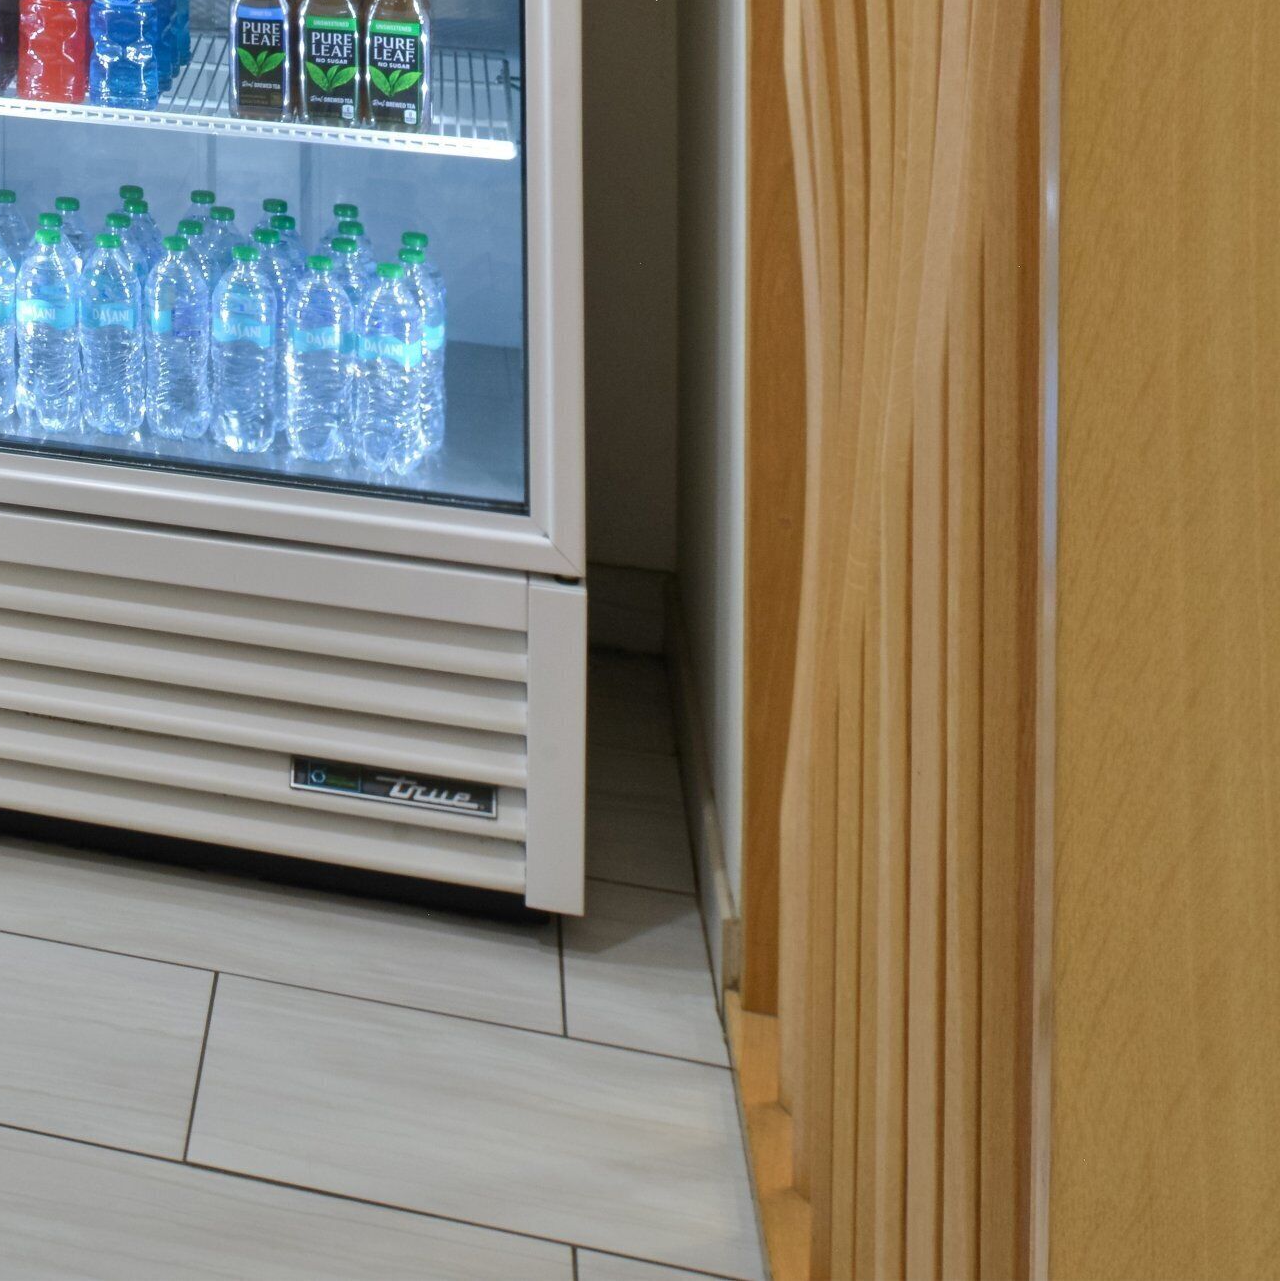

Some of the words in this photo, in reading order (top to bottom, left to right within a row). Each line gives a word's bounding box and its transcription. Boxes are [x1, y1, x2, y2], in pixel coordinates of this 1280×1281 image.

[242, 21, 280, 35] PURE
[311, 32, 353, 45] PURE
[374, 35, 416, 50] PURE
[93, 308, 131, 322] DASANI
[223, 323, 262, 339] DASANI
[364, 339, 404, 357] DASANI
[376, 774, 479, 810] true
